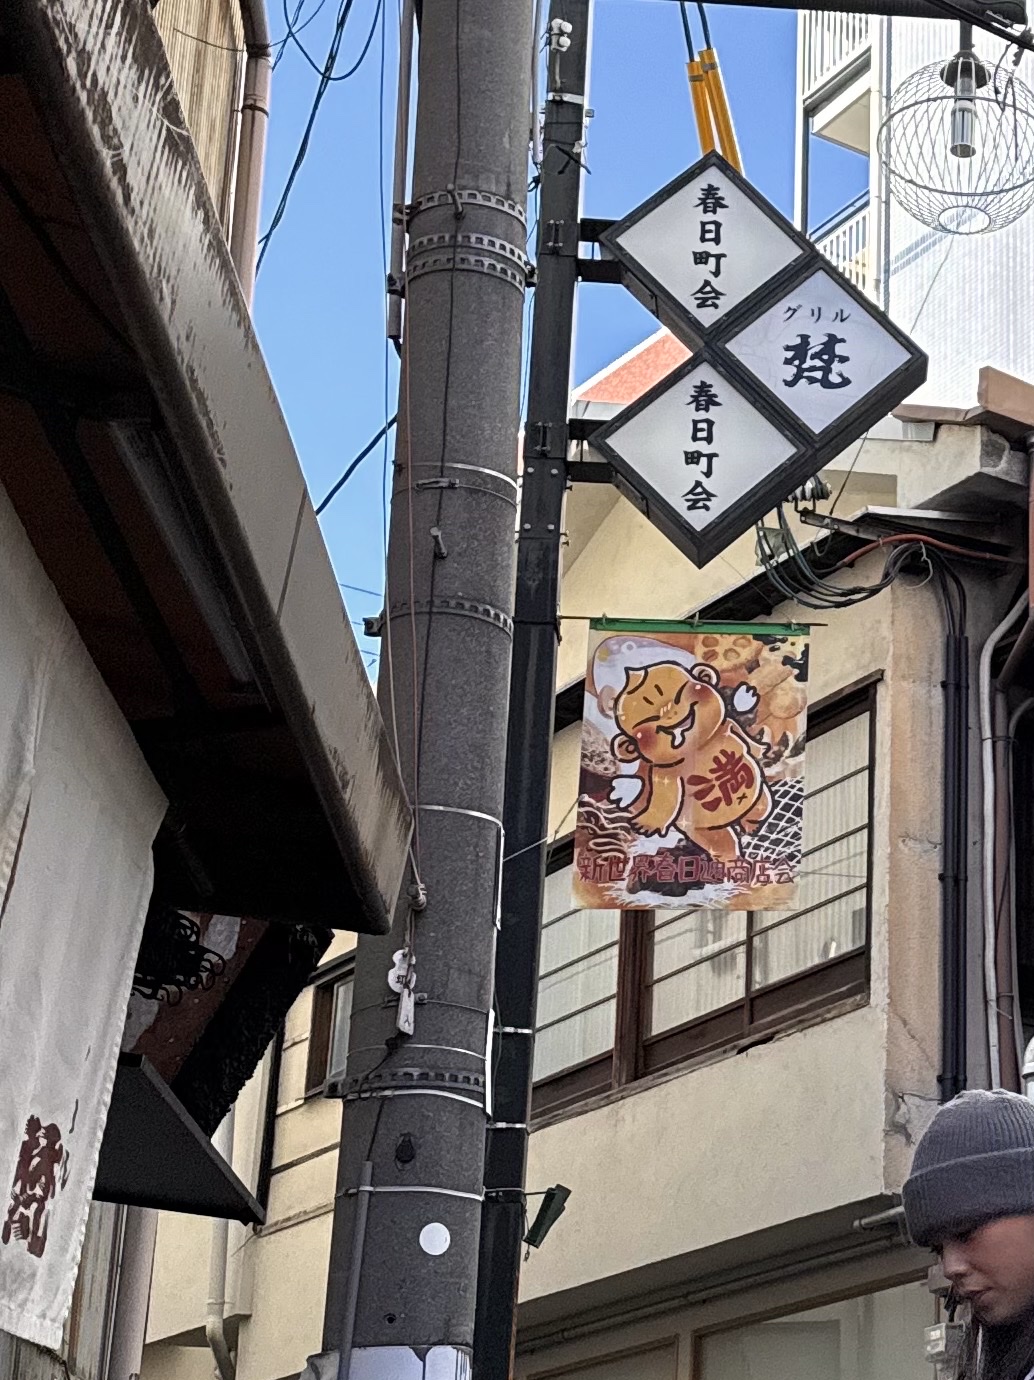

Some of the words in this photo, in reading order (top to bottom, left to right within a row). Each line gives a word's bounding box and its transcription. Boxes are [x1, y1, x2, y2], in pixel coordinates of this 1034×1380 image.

[690, 183, 729, 310] 春日町会
[783, 304, 852, 324] グリル
[782, 332, 852, 390] 梵
[682, 381, 723, 512] 春日町会
[687, 749, 755, 812] 満
